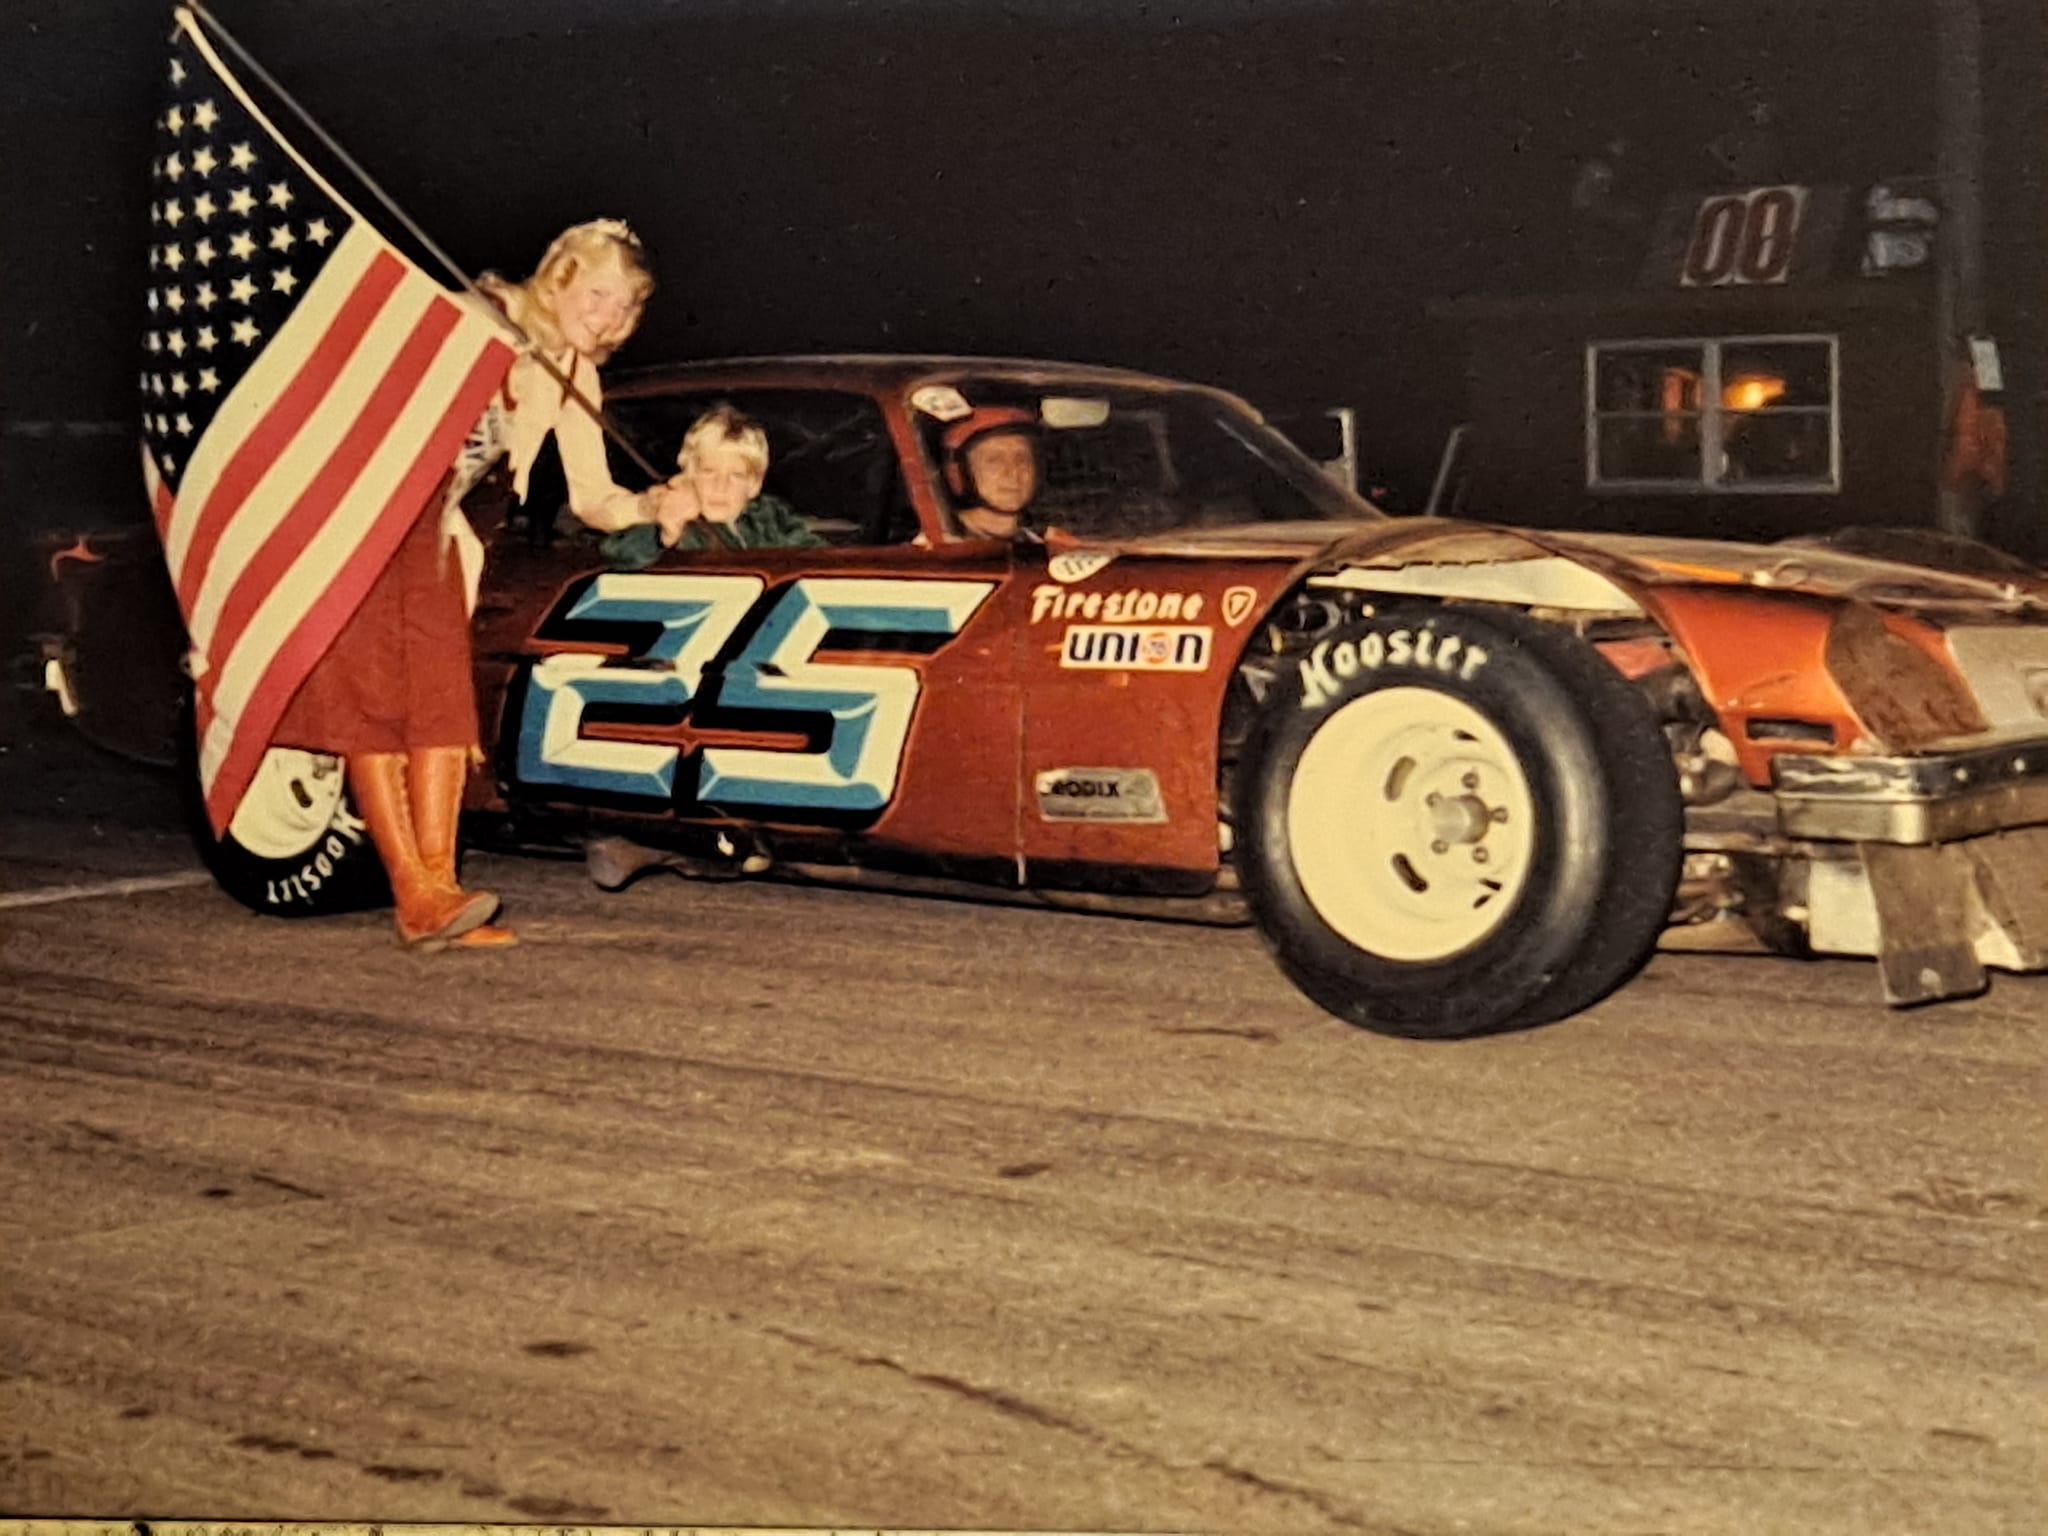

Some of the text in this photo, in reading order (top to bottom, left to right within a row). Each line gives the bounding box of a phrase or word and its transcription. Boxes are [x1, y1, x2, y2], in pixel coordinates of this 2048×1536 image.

[1030, 584, 1204, 624] Firestone
[500, 571, 999, 828] 25
[1299, 618, 1488, 709] Hoosier
